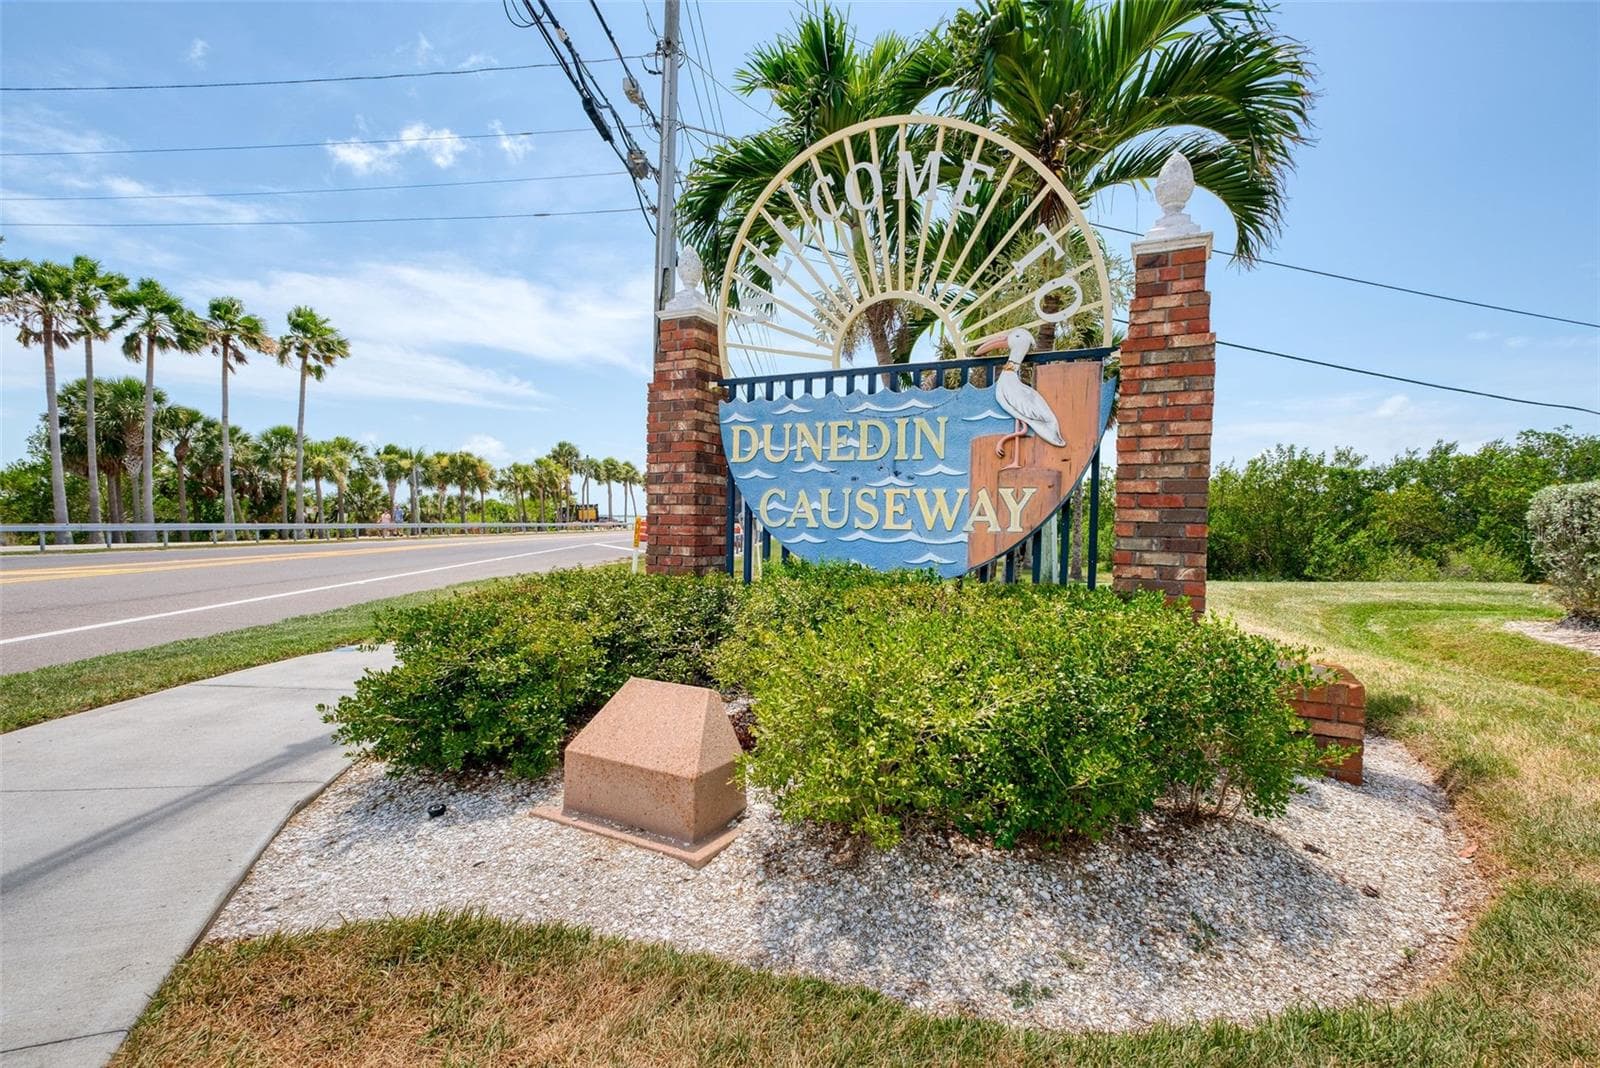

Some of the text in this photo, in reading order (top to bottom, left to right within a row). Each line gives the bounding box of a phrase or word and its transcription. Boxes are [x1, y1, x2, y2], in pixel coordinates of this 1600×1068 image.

[736, 151, 1082, 325] WELCOME TO
[730, 416, 949, 464] DUNEDIN
[758, 486, 1037, 533] CAUSEWAY
